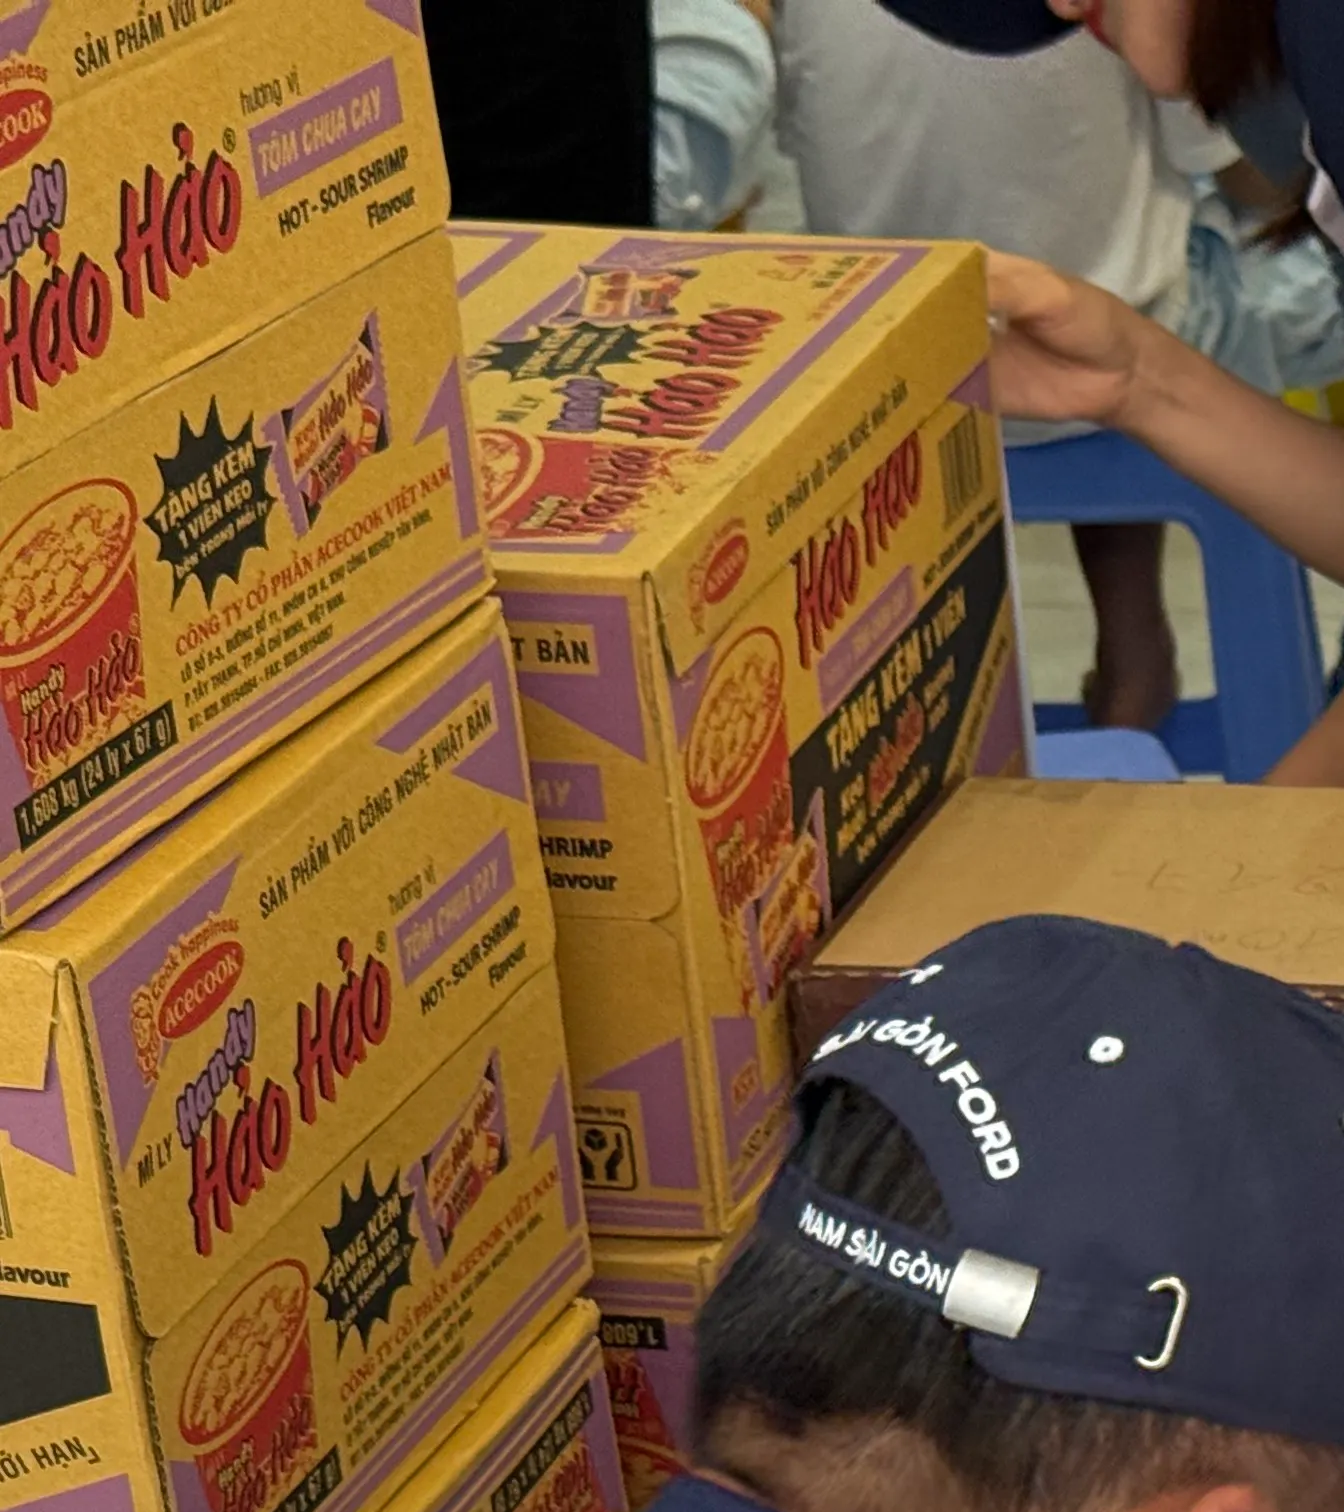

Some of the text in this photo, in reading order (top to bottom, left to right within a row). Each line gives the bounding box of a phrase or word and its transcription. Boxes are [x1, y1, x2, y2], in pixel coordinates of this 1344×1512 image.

[74, 31, 111, 77] SẢN
[257, 130, 299, 177] TÔM
[350, 85, 382, 133] CAY
[114, 121, 242, 320] Hảo
[277, 198, 311, 239] HOT
[319, 174, 360, 214] SOUR
[357, 144, 409, 193] SHRIMP
[154, 471, 213, 534] TẶNG
[211, 440, 257, 490] KÈM
[174, 613, 222, 657] CÔNG
[221, 600, 245, 632] TY
[537, 628, 591, 665] BẢN
[19, 787, 60, 837] 1,608
[60, 775, 80, 808] kg
[134, 719, 152, 755] 67
[535, 778, 571, 808] AY
[539, 836, 615, 860] HRIMP
[545, 866, 618, 892] lavour
[176, 998, 257, 1150] Handy
[188, 936, 393, 1258] Hảo Hảo
[872, 1014, 1021, 1181] GÒN FORD
[798, 1202, 843, 1250] NAM
[887, 1249, 951, 1296] GÒN
[30, 1436, 88, 1469] HẠN
